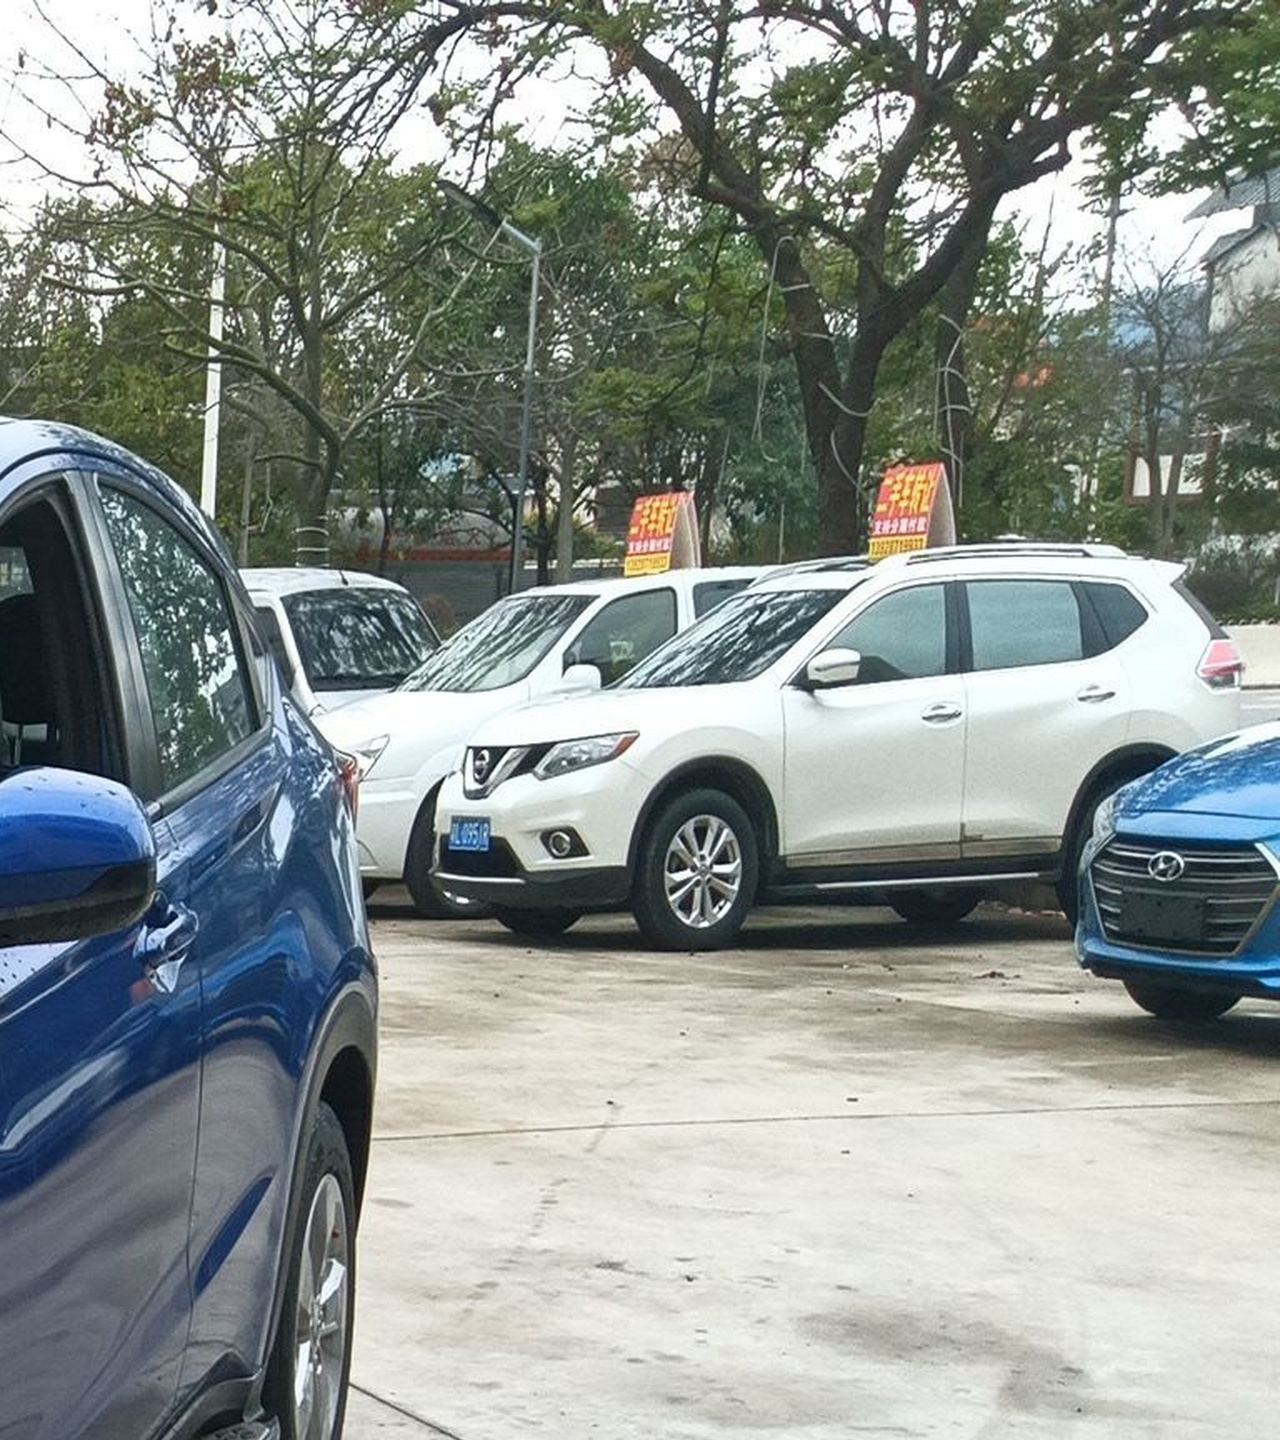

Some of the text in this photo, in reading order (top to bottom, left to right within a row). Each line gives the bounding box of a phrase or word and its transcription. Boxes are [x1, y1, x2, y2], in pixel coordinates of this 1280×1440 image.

[877, 468, 936, 516] 二手车转让
[628, 496, 678, 537] 二手车转让
